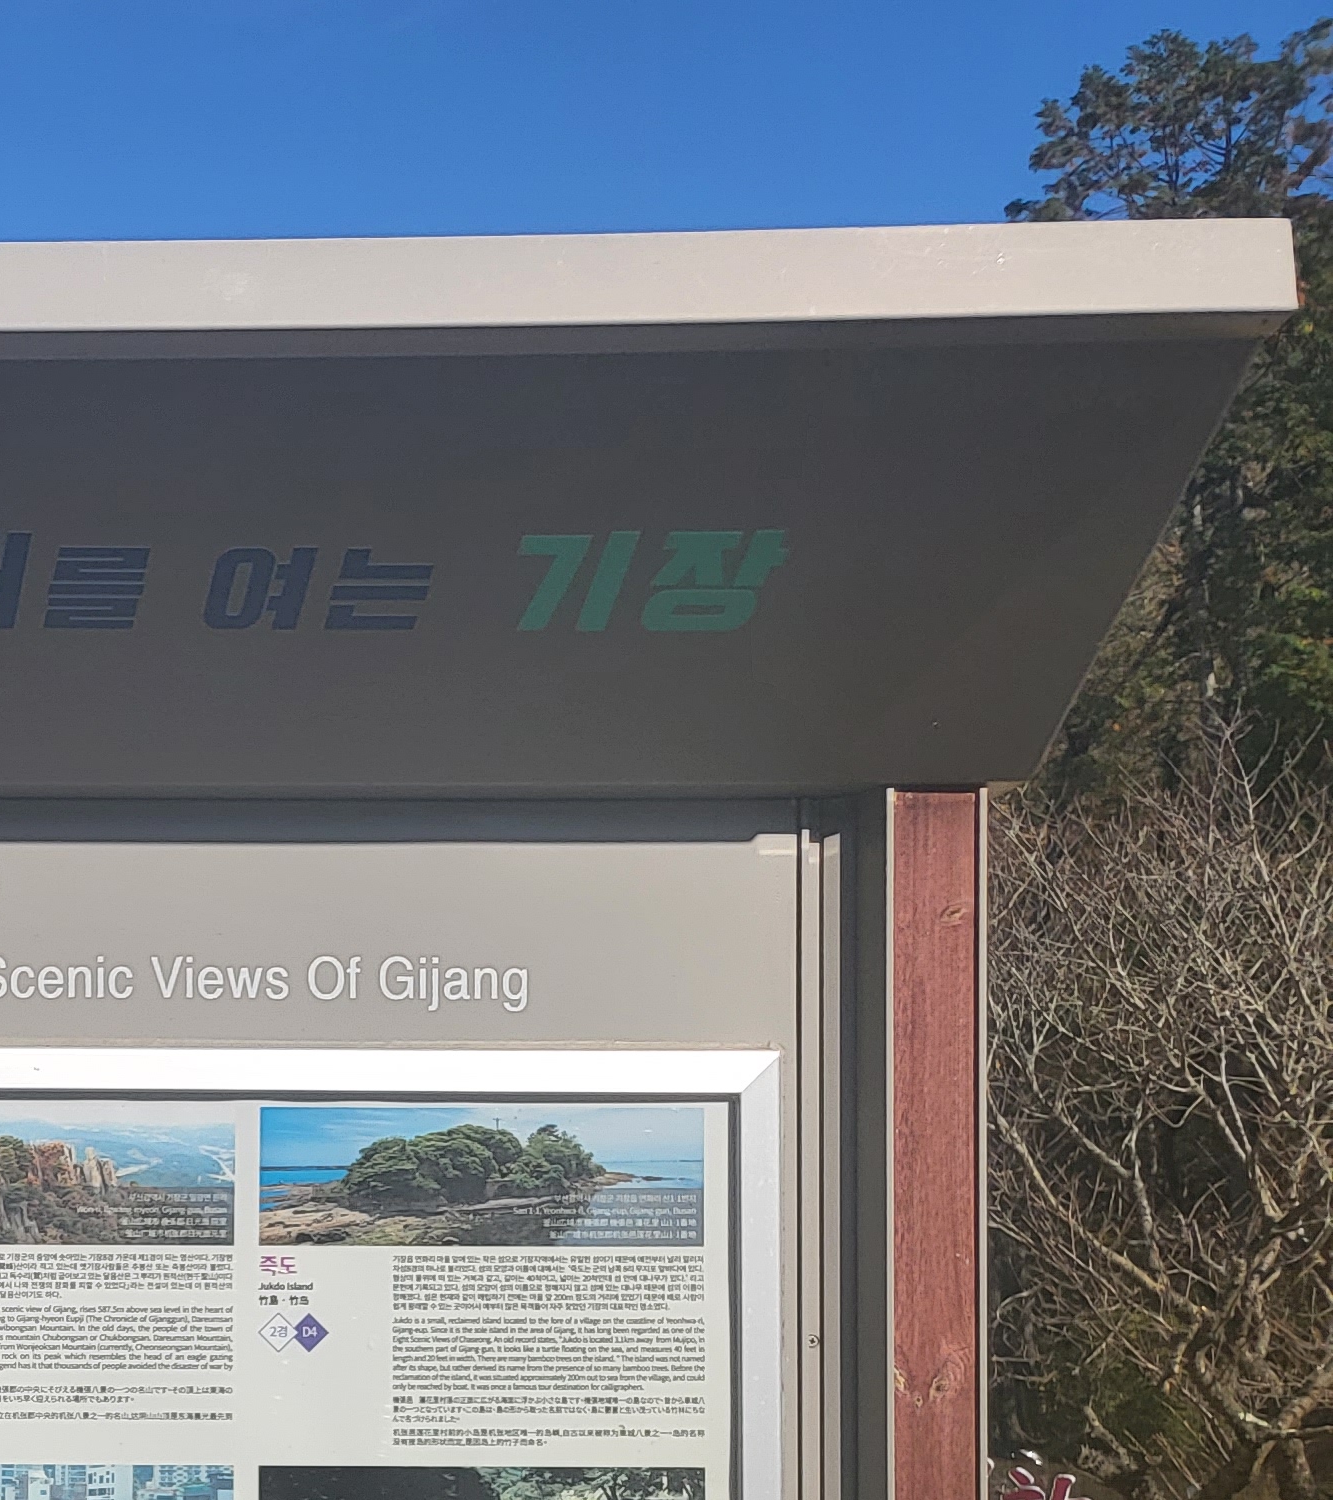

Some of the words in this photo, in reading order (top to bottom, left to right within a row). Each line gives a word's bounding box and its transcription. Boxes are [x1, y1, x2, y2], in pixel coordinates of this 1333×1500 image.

[201, 547, 434, 632] 여는
[513, 530, 789, 634] 기장
[150, 955, 290, 1001] Views
[307, 954, 362, 1001] Of
[378, 954, 529, 1013] Gijang
[259, 1256, 297, 1276] 죽도
[258, 1282, 285, 1290] Jukdo
[287, 1282, 313, 1290] Island
[269, 1324, 288, 1339] 2경
[301, 1326, 318, 1338] D4
